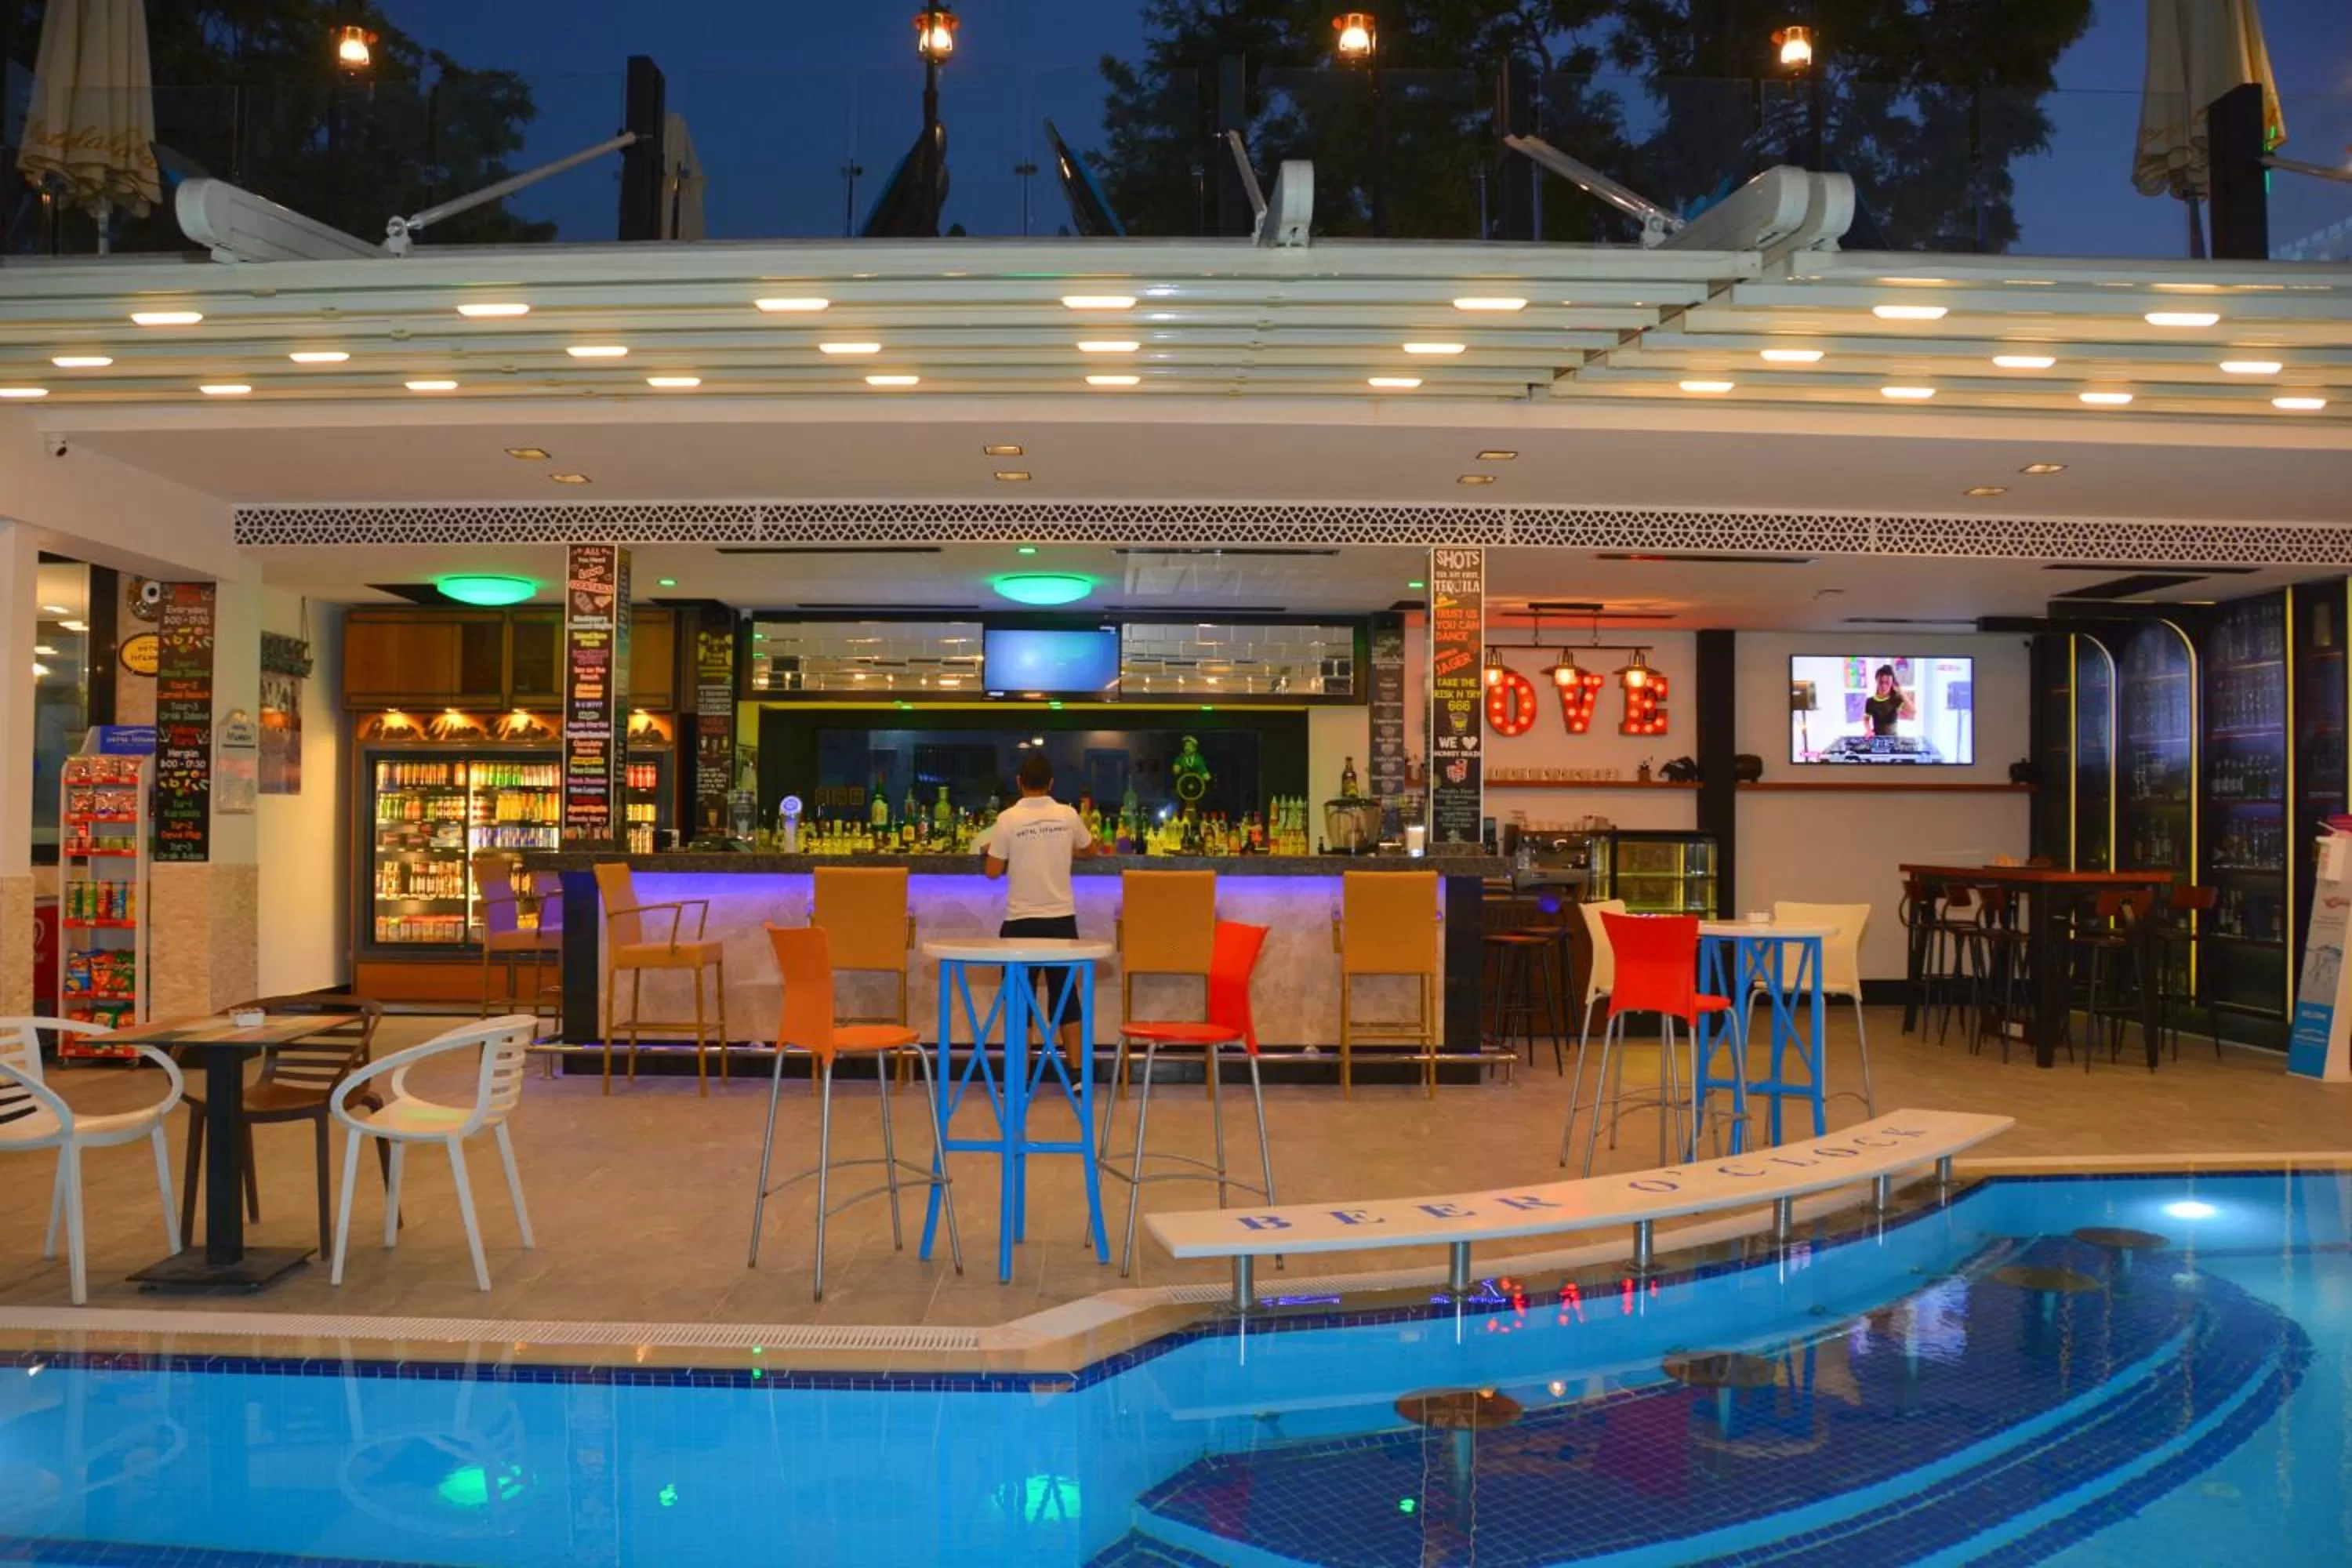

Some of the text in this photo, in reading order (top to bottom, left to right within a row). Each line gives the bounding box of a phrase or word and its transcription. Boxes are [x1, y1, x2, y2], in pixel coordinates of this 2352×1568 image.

[1436, 550, 1480, 568] SHOTS
[1434, 579, 1480, 596] TEQUILA
[1436, 620, 1480, 630] YOU CAN
[1436, 631, 1468, 641] DANCE
[1437, 678, 1458, 687] TAKE
[1447, 700, 1472, 712] 666
[1485, 672, 1668, 737] OVE
[1438, 736, 1457, 749] WE
[1234, 1125, 1927, 1231] BEER O'CLOCK
